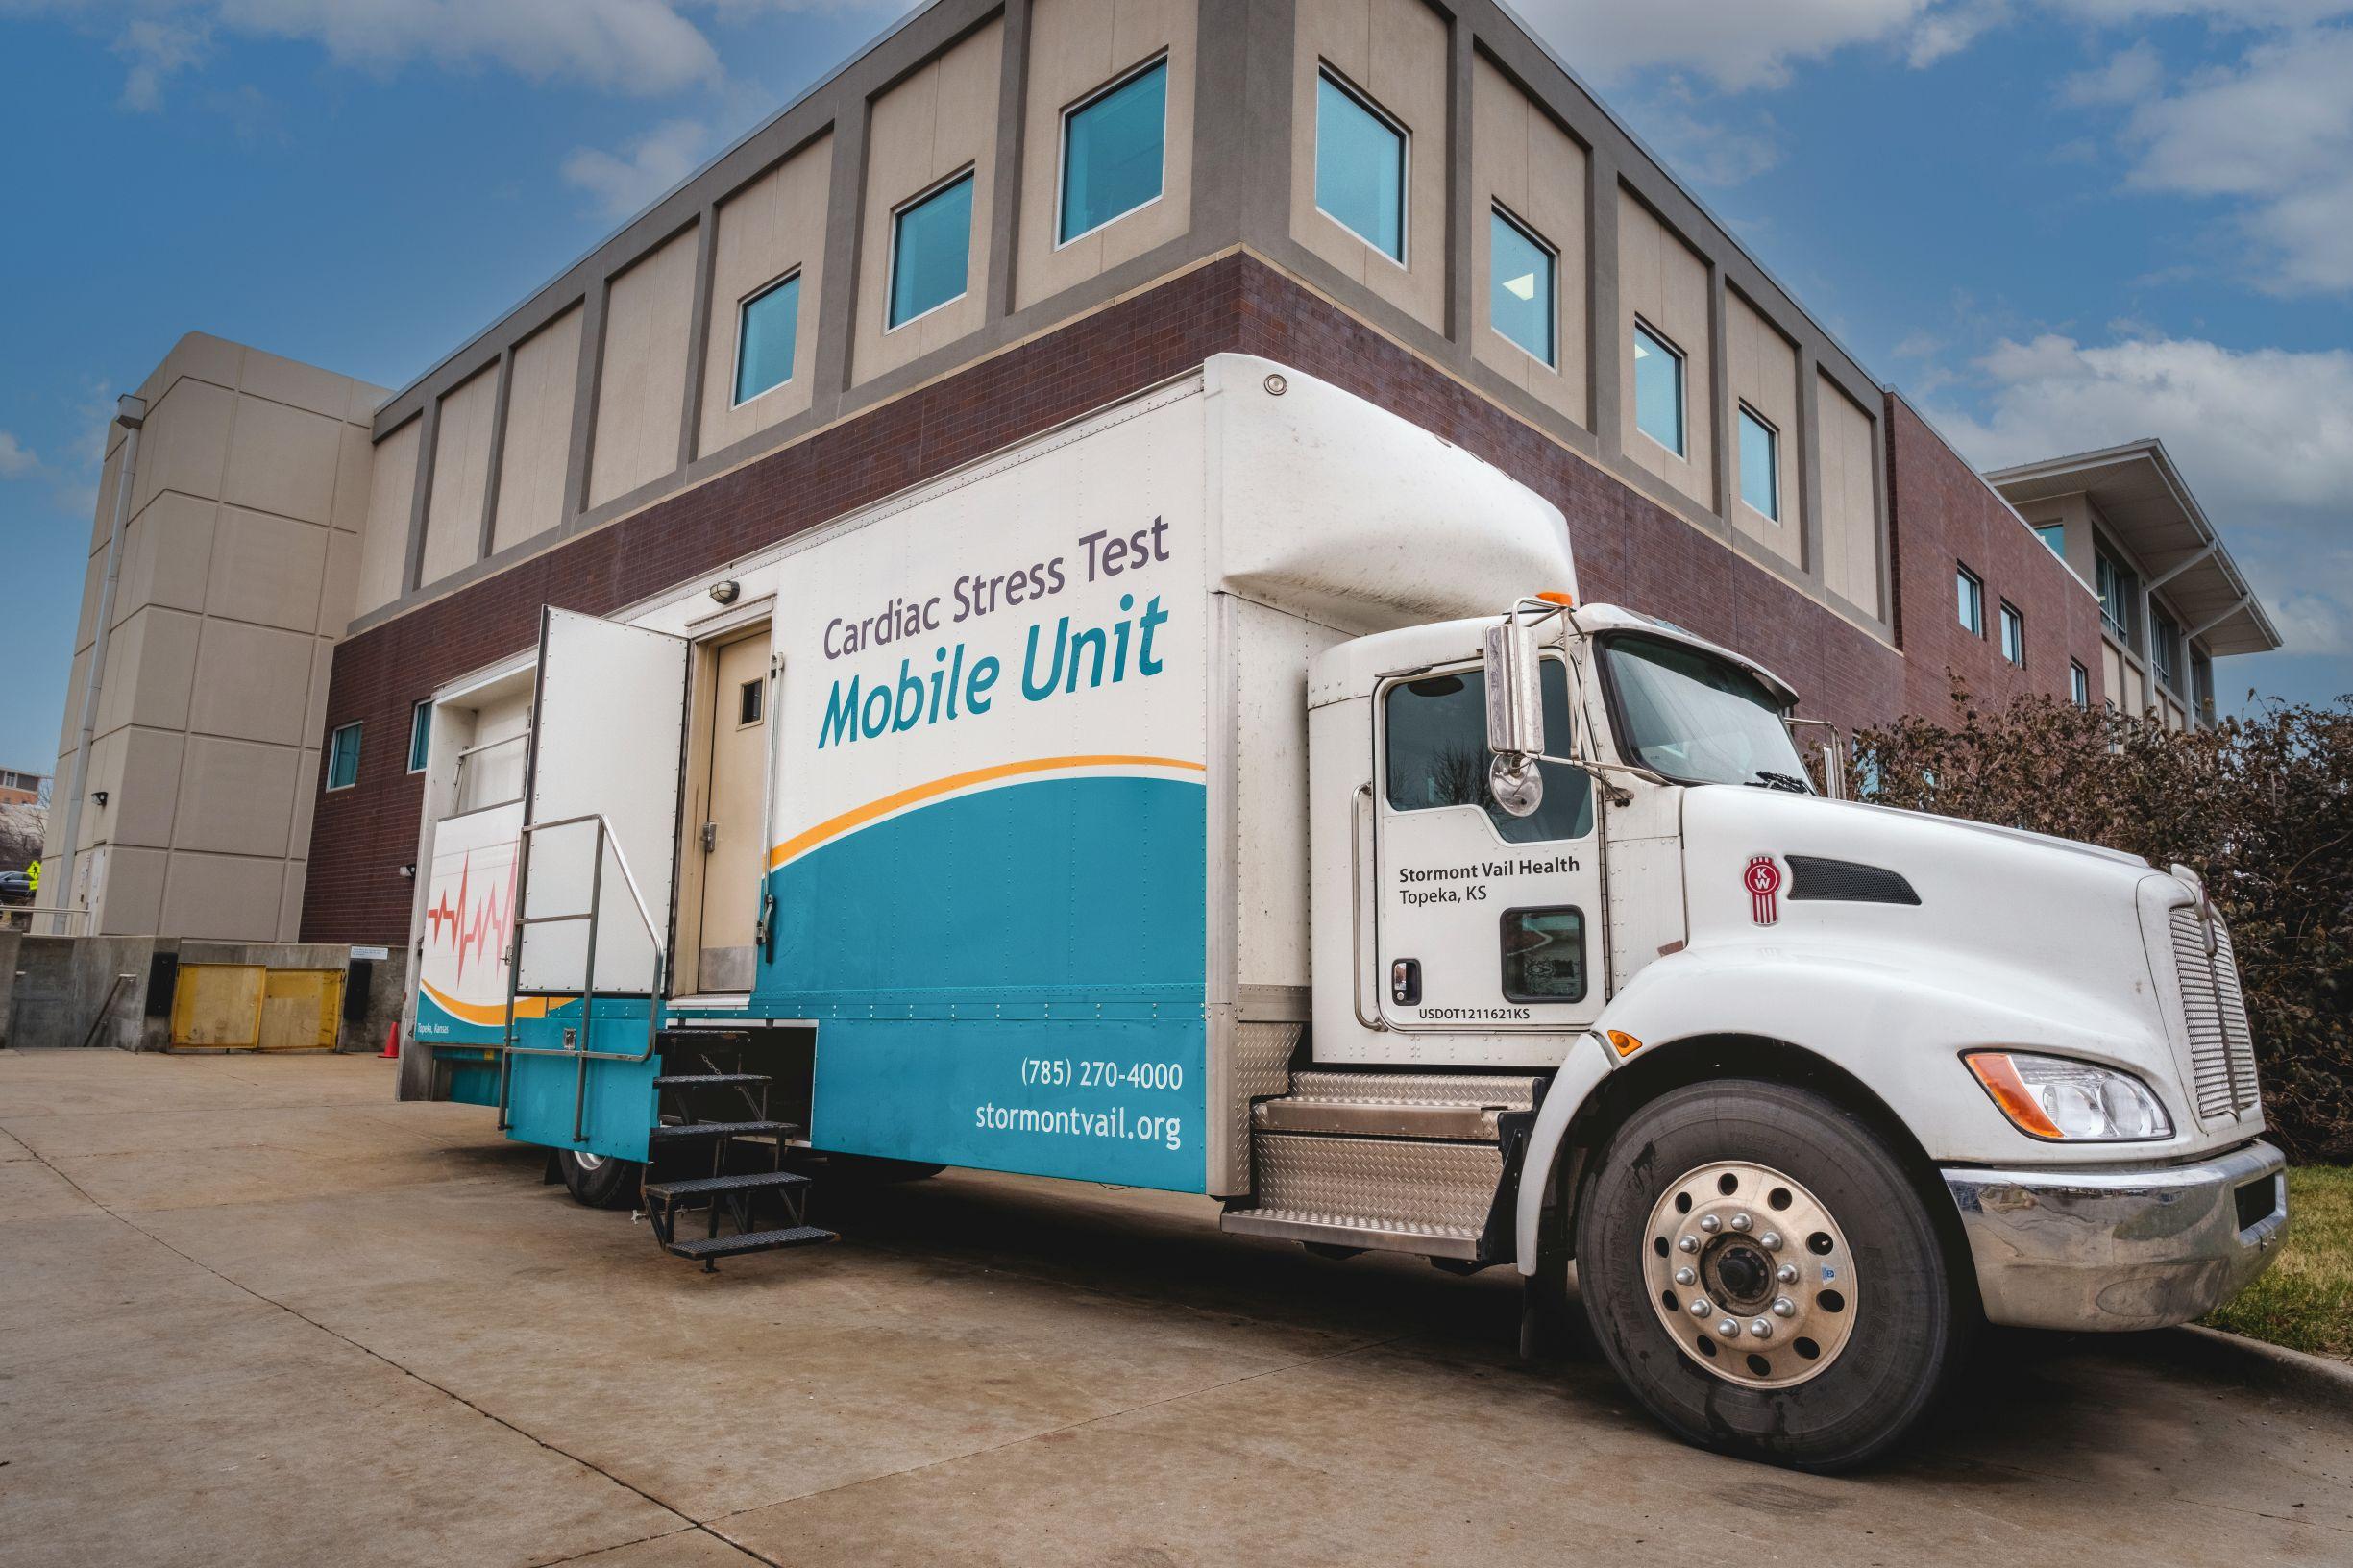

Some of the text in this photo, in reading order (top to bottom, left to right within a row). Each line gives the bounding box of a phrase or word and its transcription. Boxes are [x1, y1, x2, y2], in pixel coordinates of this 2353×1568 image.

[823, 515, 1170, 660] Cardiac Stress Test
[818, 594, 1169, 748] Mobile Unit
[1399, 856, 1580, 883] Stormont Vail Health
[1399, 885, 1487, 907] Topeka, KS
[1419, 1008, 1531, 1019] USDOT1211621KS
[417, 1023, 450, 1035] Topeka, Kansas
[1021, 1056, 1183, 1090] (785) 270-4000
[975, 1102, 1181, 1151] stormontvail.org
